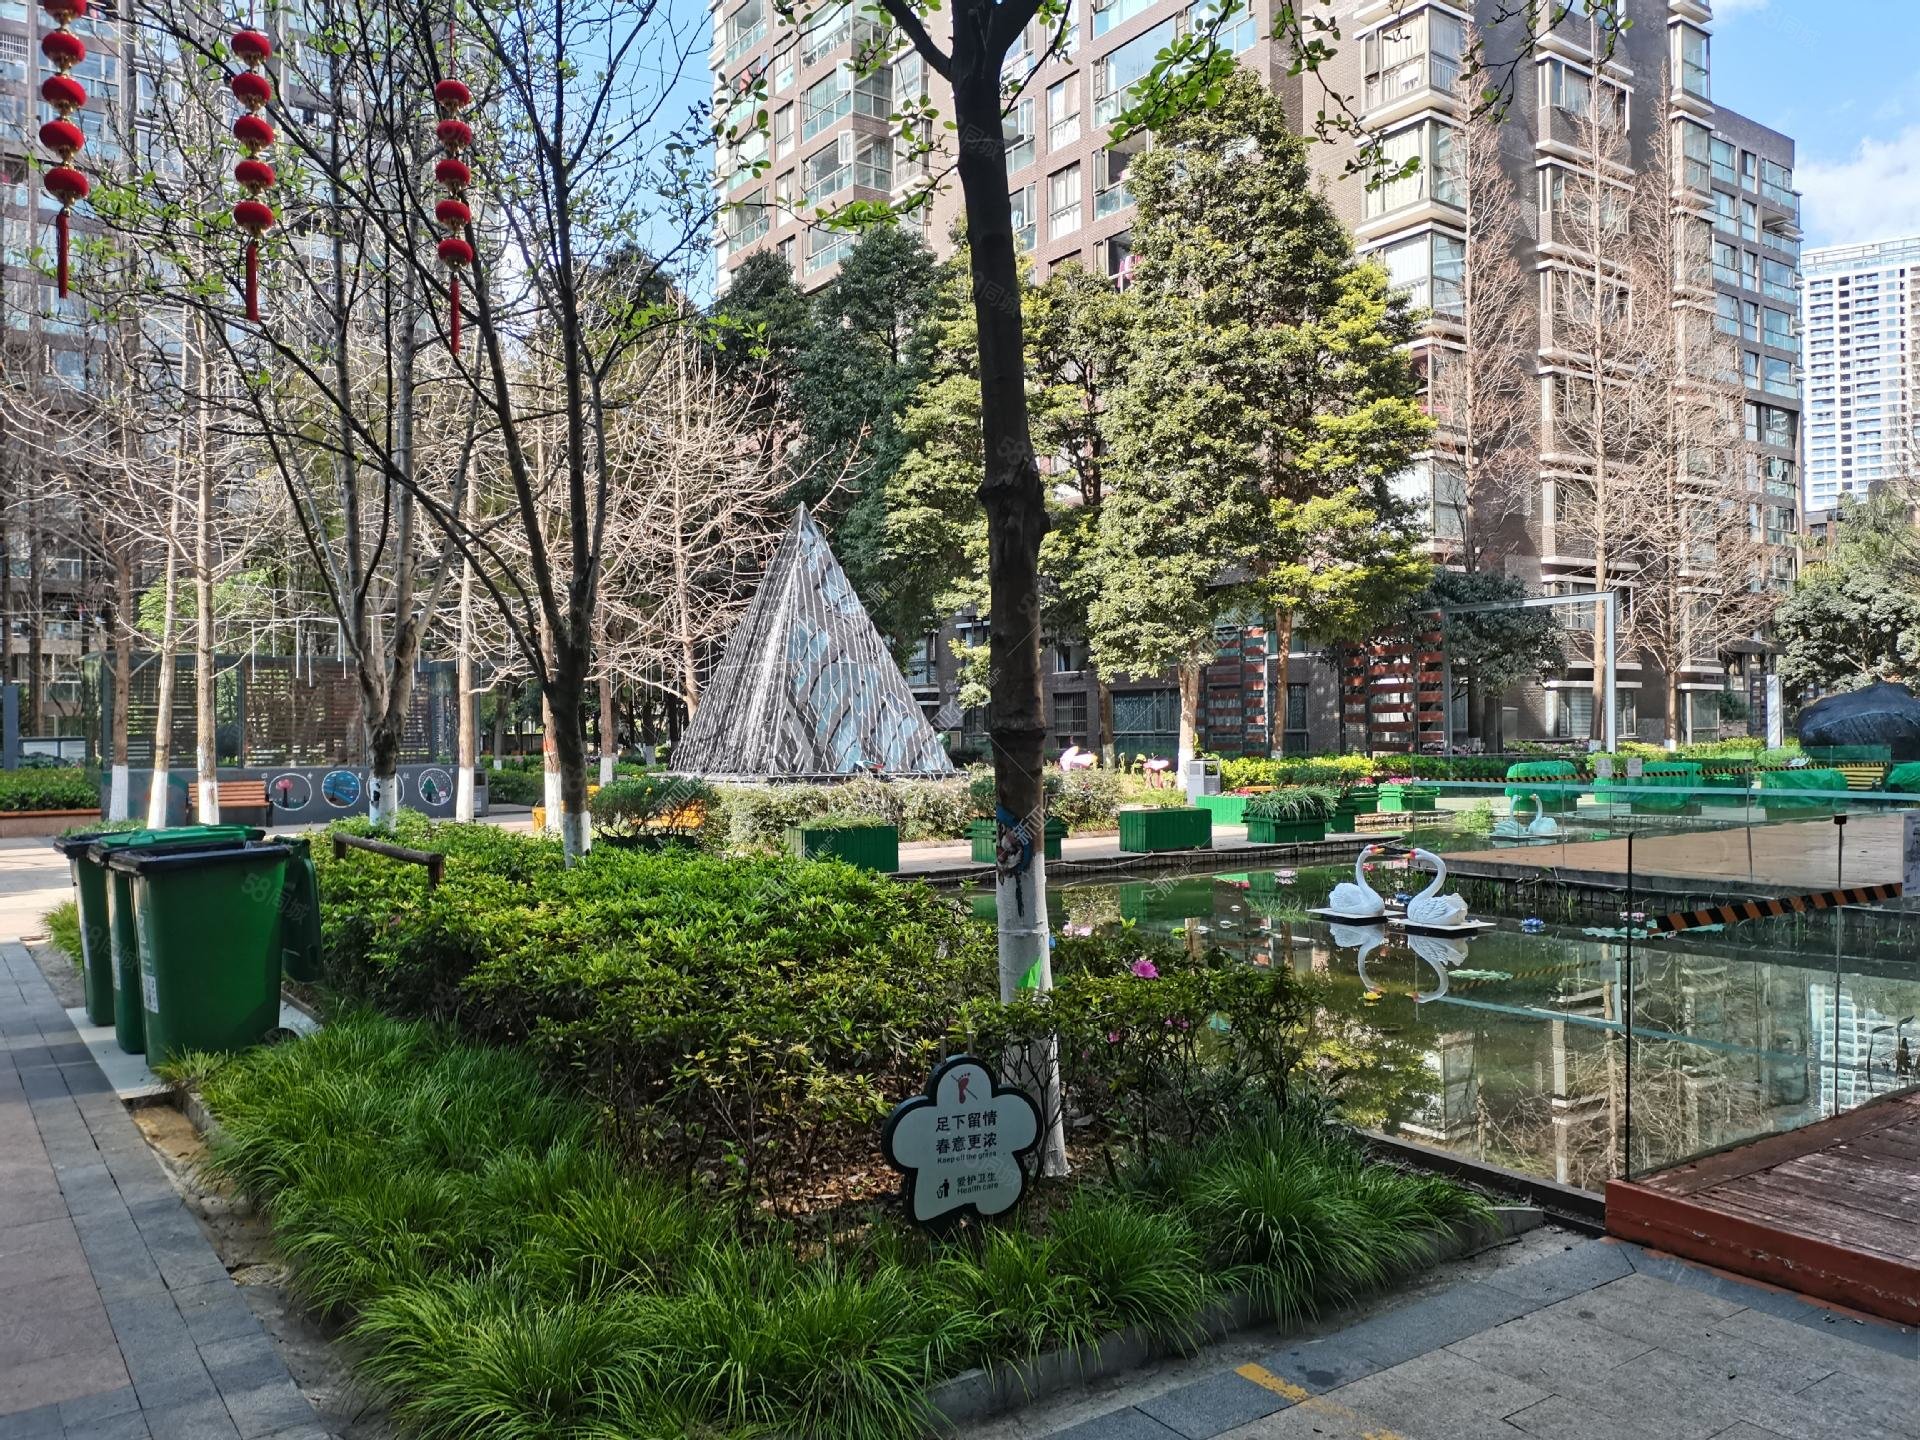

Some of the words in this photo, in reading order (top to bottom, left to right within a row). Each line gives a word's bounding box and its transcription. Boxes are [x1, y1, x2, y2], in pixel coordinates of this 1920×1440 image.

[936, 1109, 998, 1133] 足下留情
[936, 1132, 998, 1155] 春意更浓
[937, 1156, 955, 1164] Keep
[956, 1153, 966, 1162] off
[966, 1152, 977, 1161] the
[957, 1172, 997, 1187] 爱护卫生
[957, 1184, 981, 1195] Health
[983, 1182, 999, 1191] care
